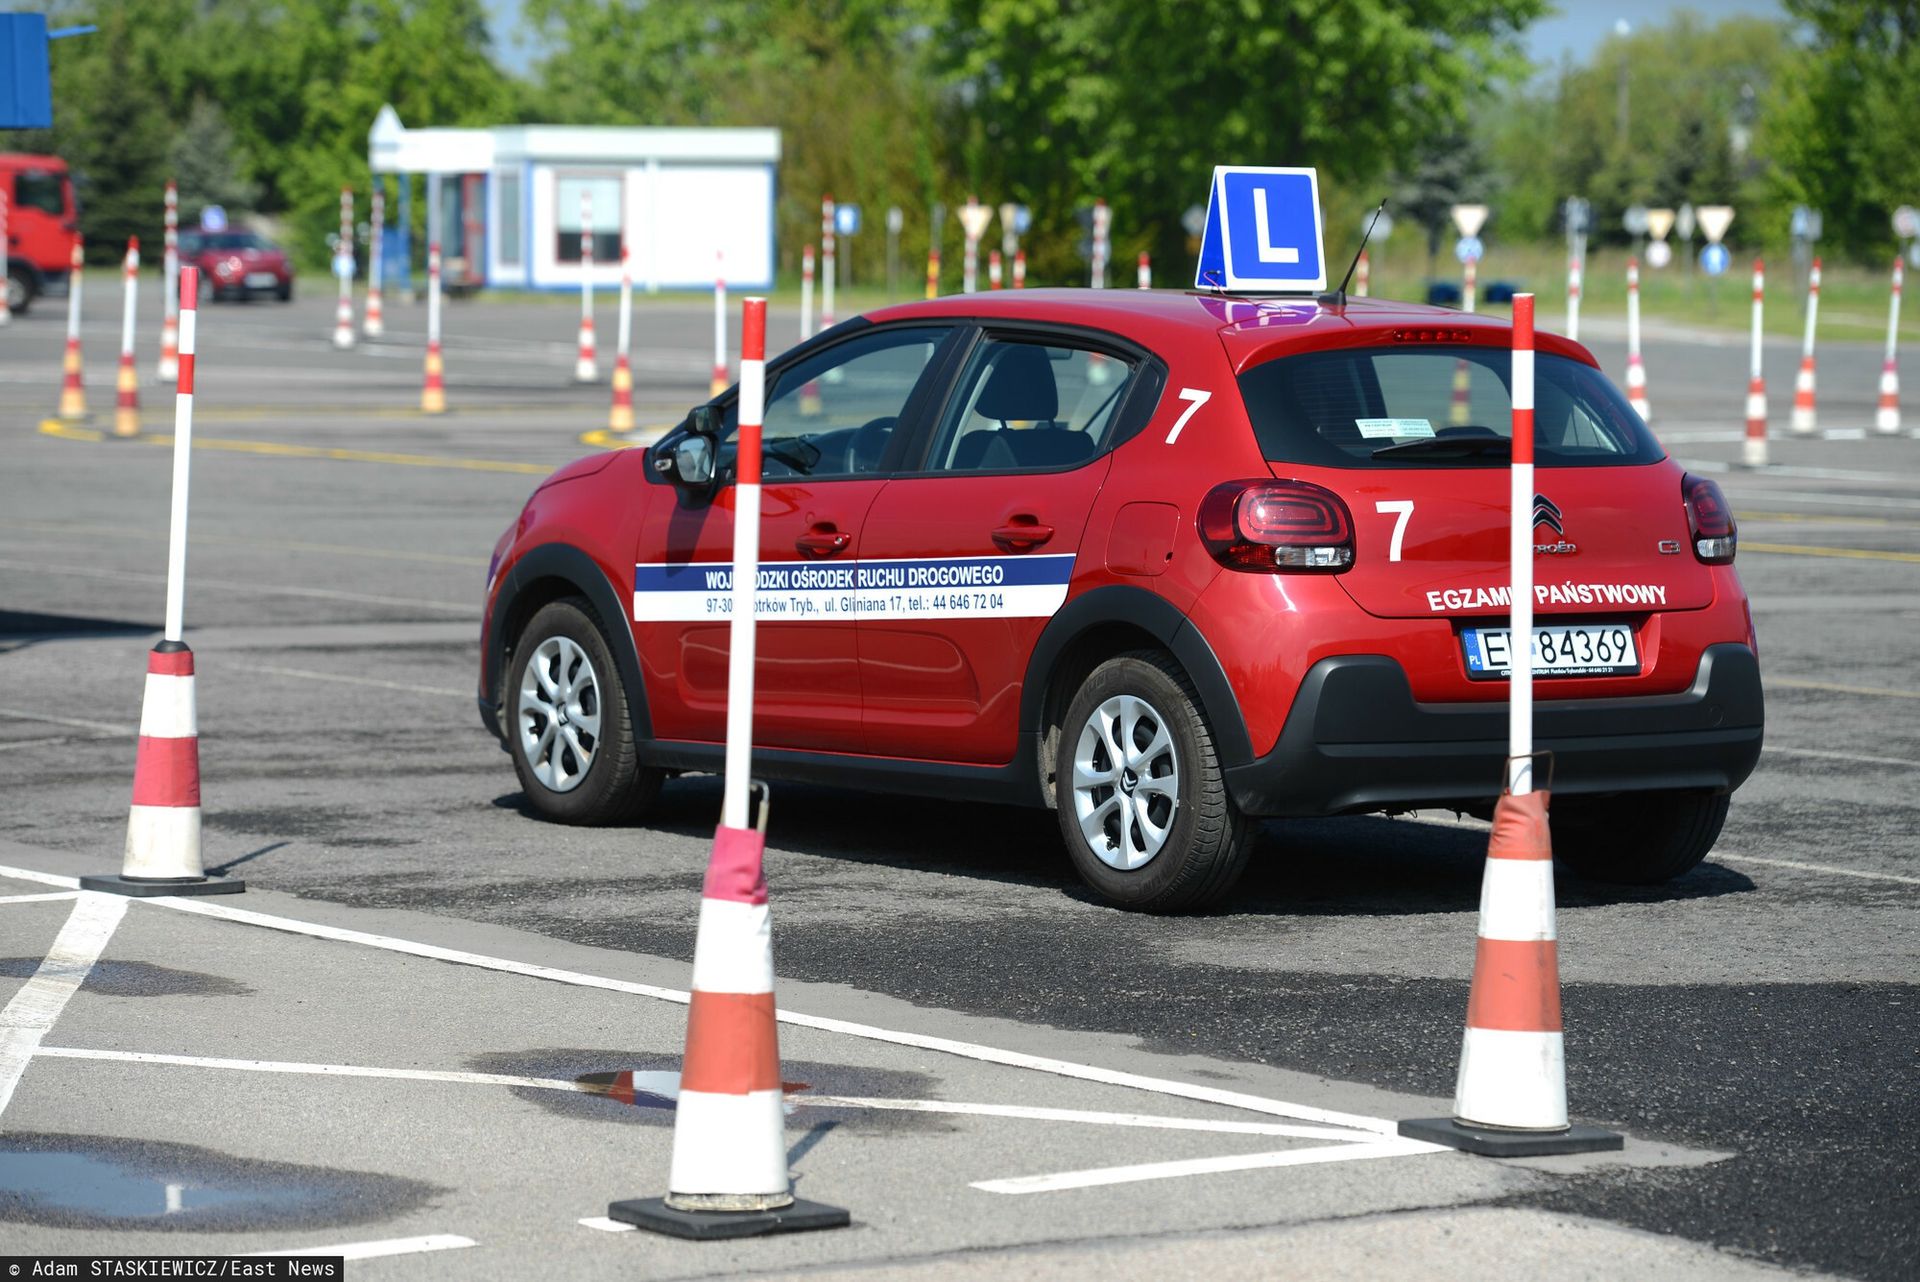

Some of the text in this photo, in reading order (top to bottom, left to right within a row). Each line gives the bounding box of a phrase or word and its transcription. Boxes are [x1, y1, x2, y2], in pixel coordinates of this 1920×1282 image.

[1253, 188, 1300, 263] L
[1165, 388, 1212, 445] 7
[1375, 500, 1414, 562] 7
[705, 564, 1004, 589] WOJDZKI OŚRODEK RUCHU DROGOWEGO
[706, 593, 1004, 617] 97-30 otrków Tryb., ul. Gliniana 17, tel.: 44 646 72 04
[1426, 580, 1667, 611] EGZAM PAŃSTWOWY
[1469, 655, 1481, 666] PL
[1539, 628, 1627, 664] 84369
